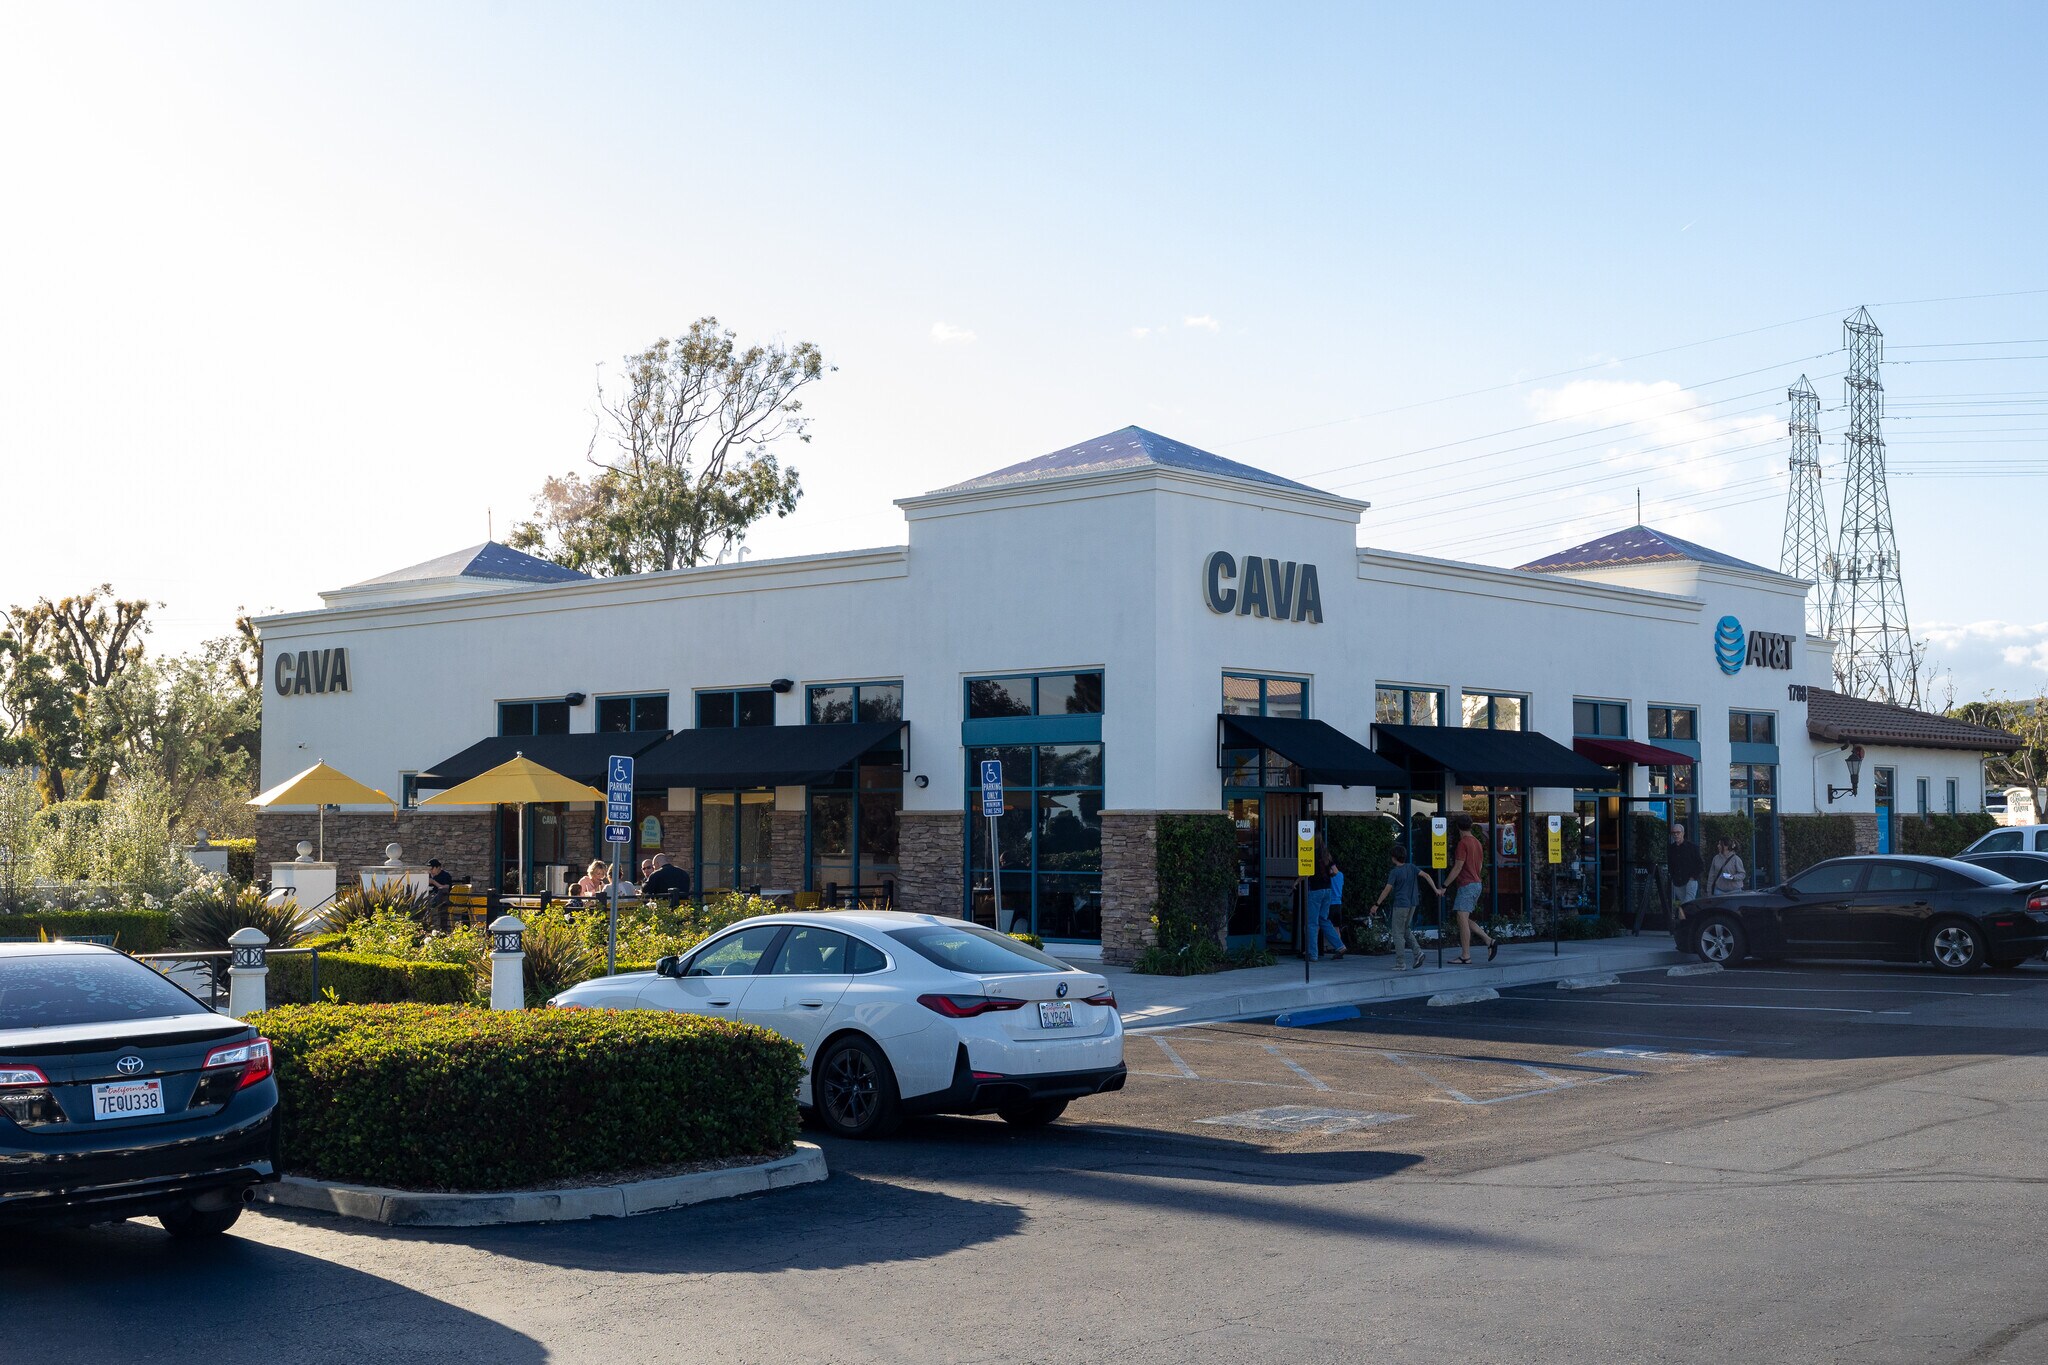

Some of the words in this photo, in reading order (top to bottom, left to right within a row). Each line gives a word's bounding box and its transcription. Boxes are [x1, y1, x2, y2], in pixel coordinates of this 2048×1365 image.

[1202, 551, 1323, 624] CAVA
[1745, 631, 1796, 670] AT&T
[275, 648, 352, 696] CAVA
[609, 782, 631, 792] PARKING
[613, 792, 627, 802] ONLY
[611, 804, 629, 812] MINIMUM
[542, 815, 557, 825] CAVA
[1235, 819, 1251, 829] CAVA
[612, 827, 624, 835] VAN
[107, 1086, 148, 1095] California
[100, 1094, 158, 1113] 7EQU338
